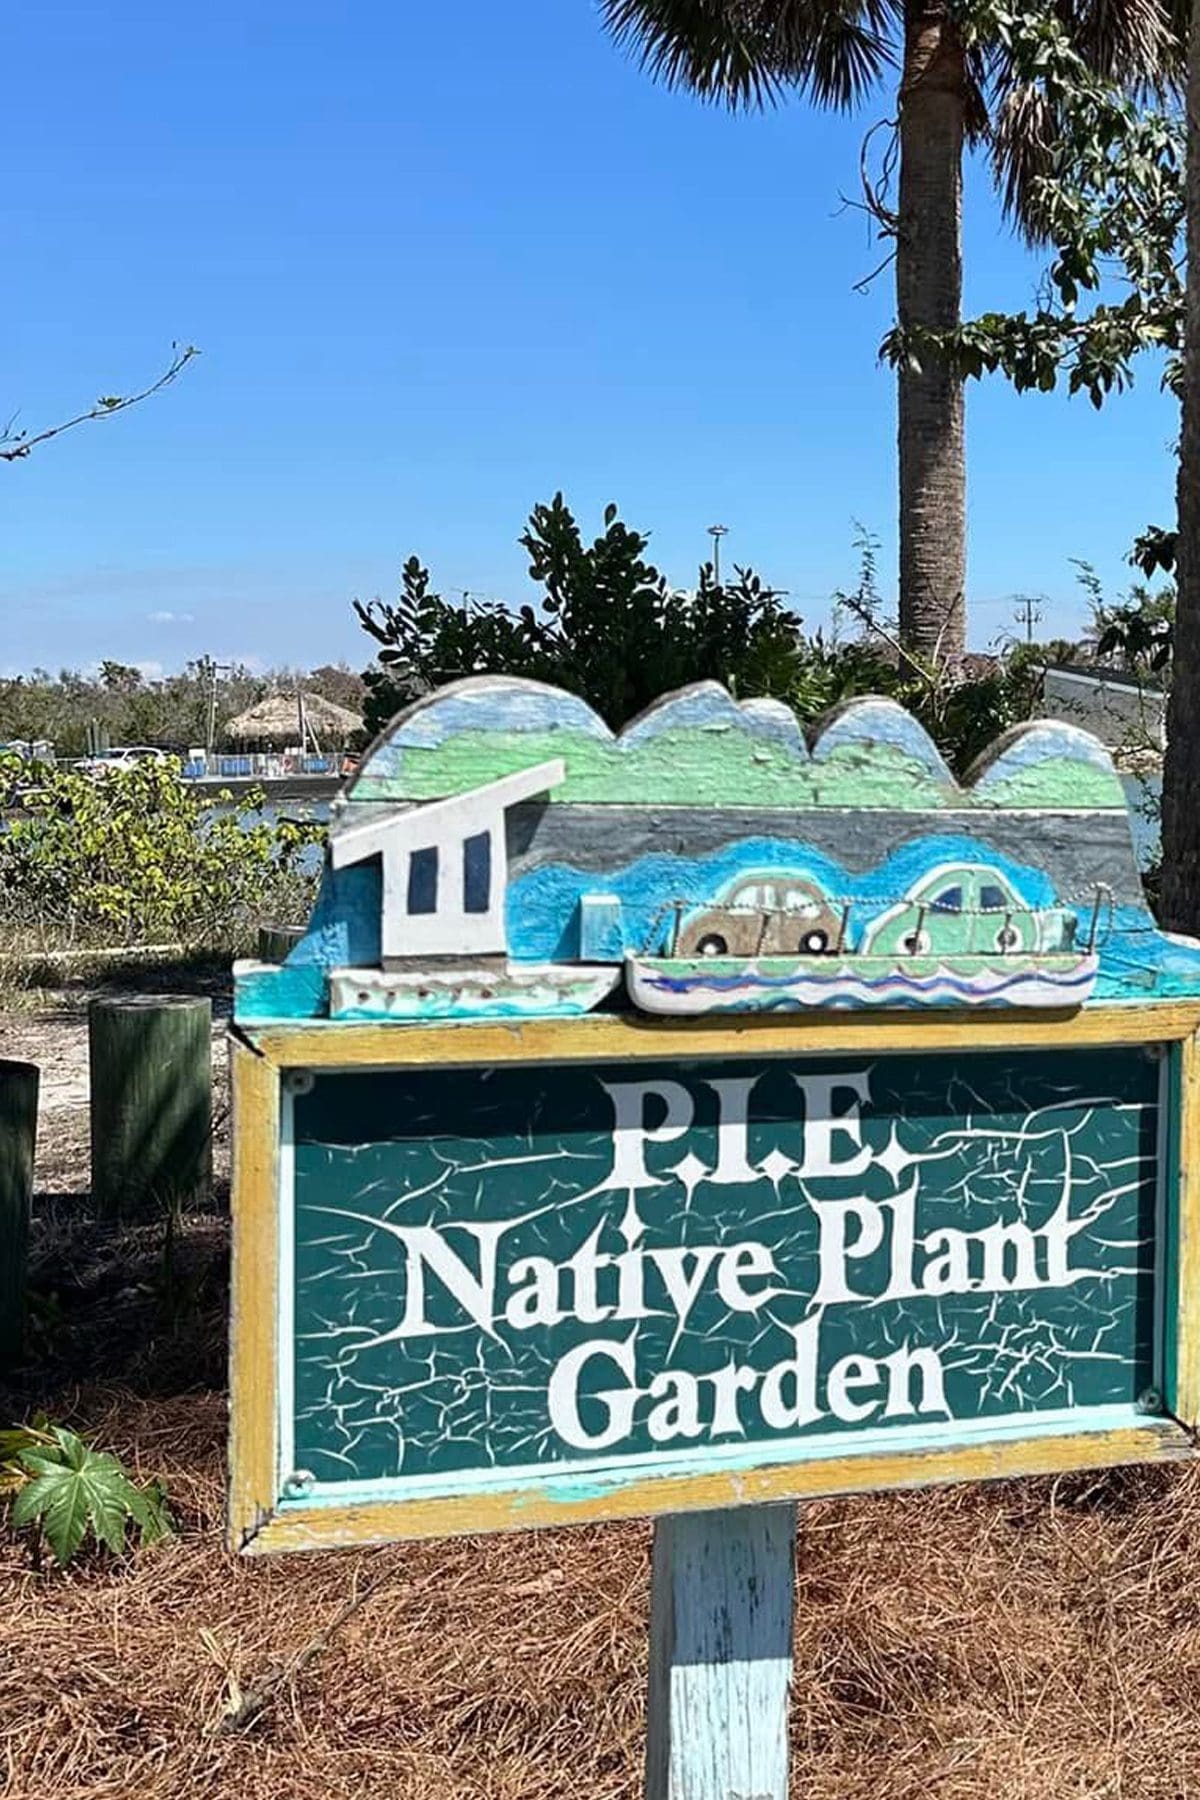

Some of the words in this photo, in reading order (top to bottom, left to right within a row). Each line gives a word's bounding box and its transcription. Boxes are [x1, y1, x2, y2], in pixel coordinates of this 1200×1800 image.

[601, 1074, 909, 1191] P.I.E.
[398, 1206, 784, 1338] Native
[806, 1184, 1080, 1304] Plant
[548, 1312, 950, 1450] Garden
